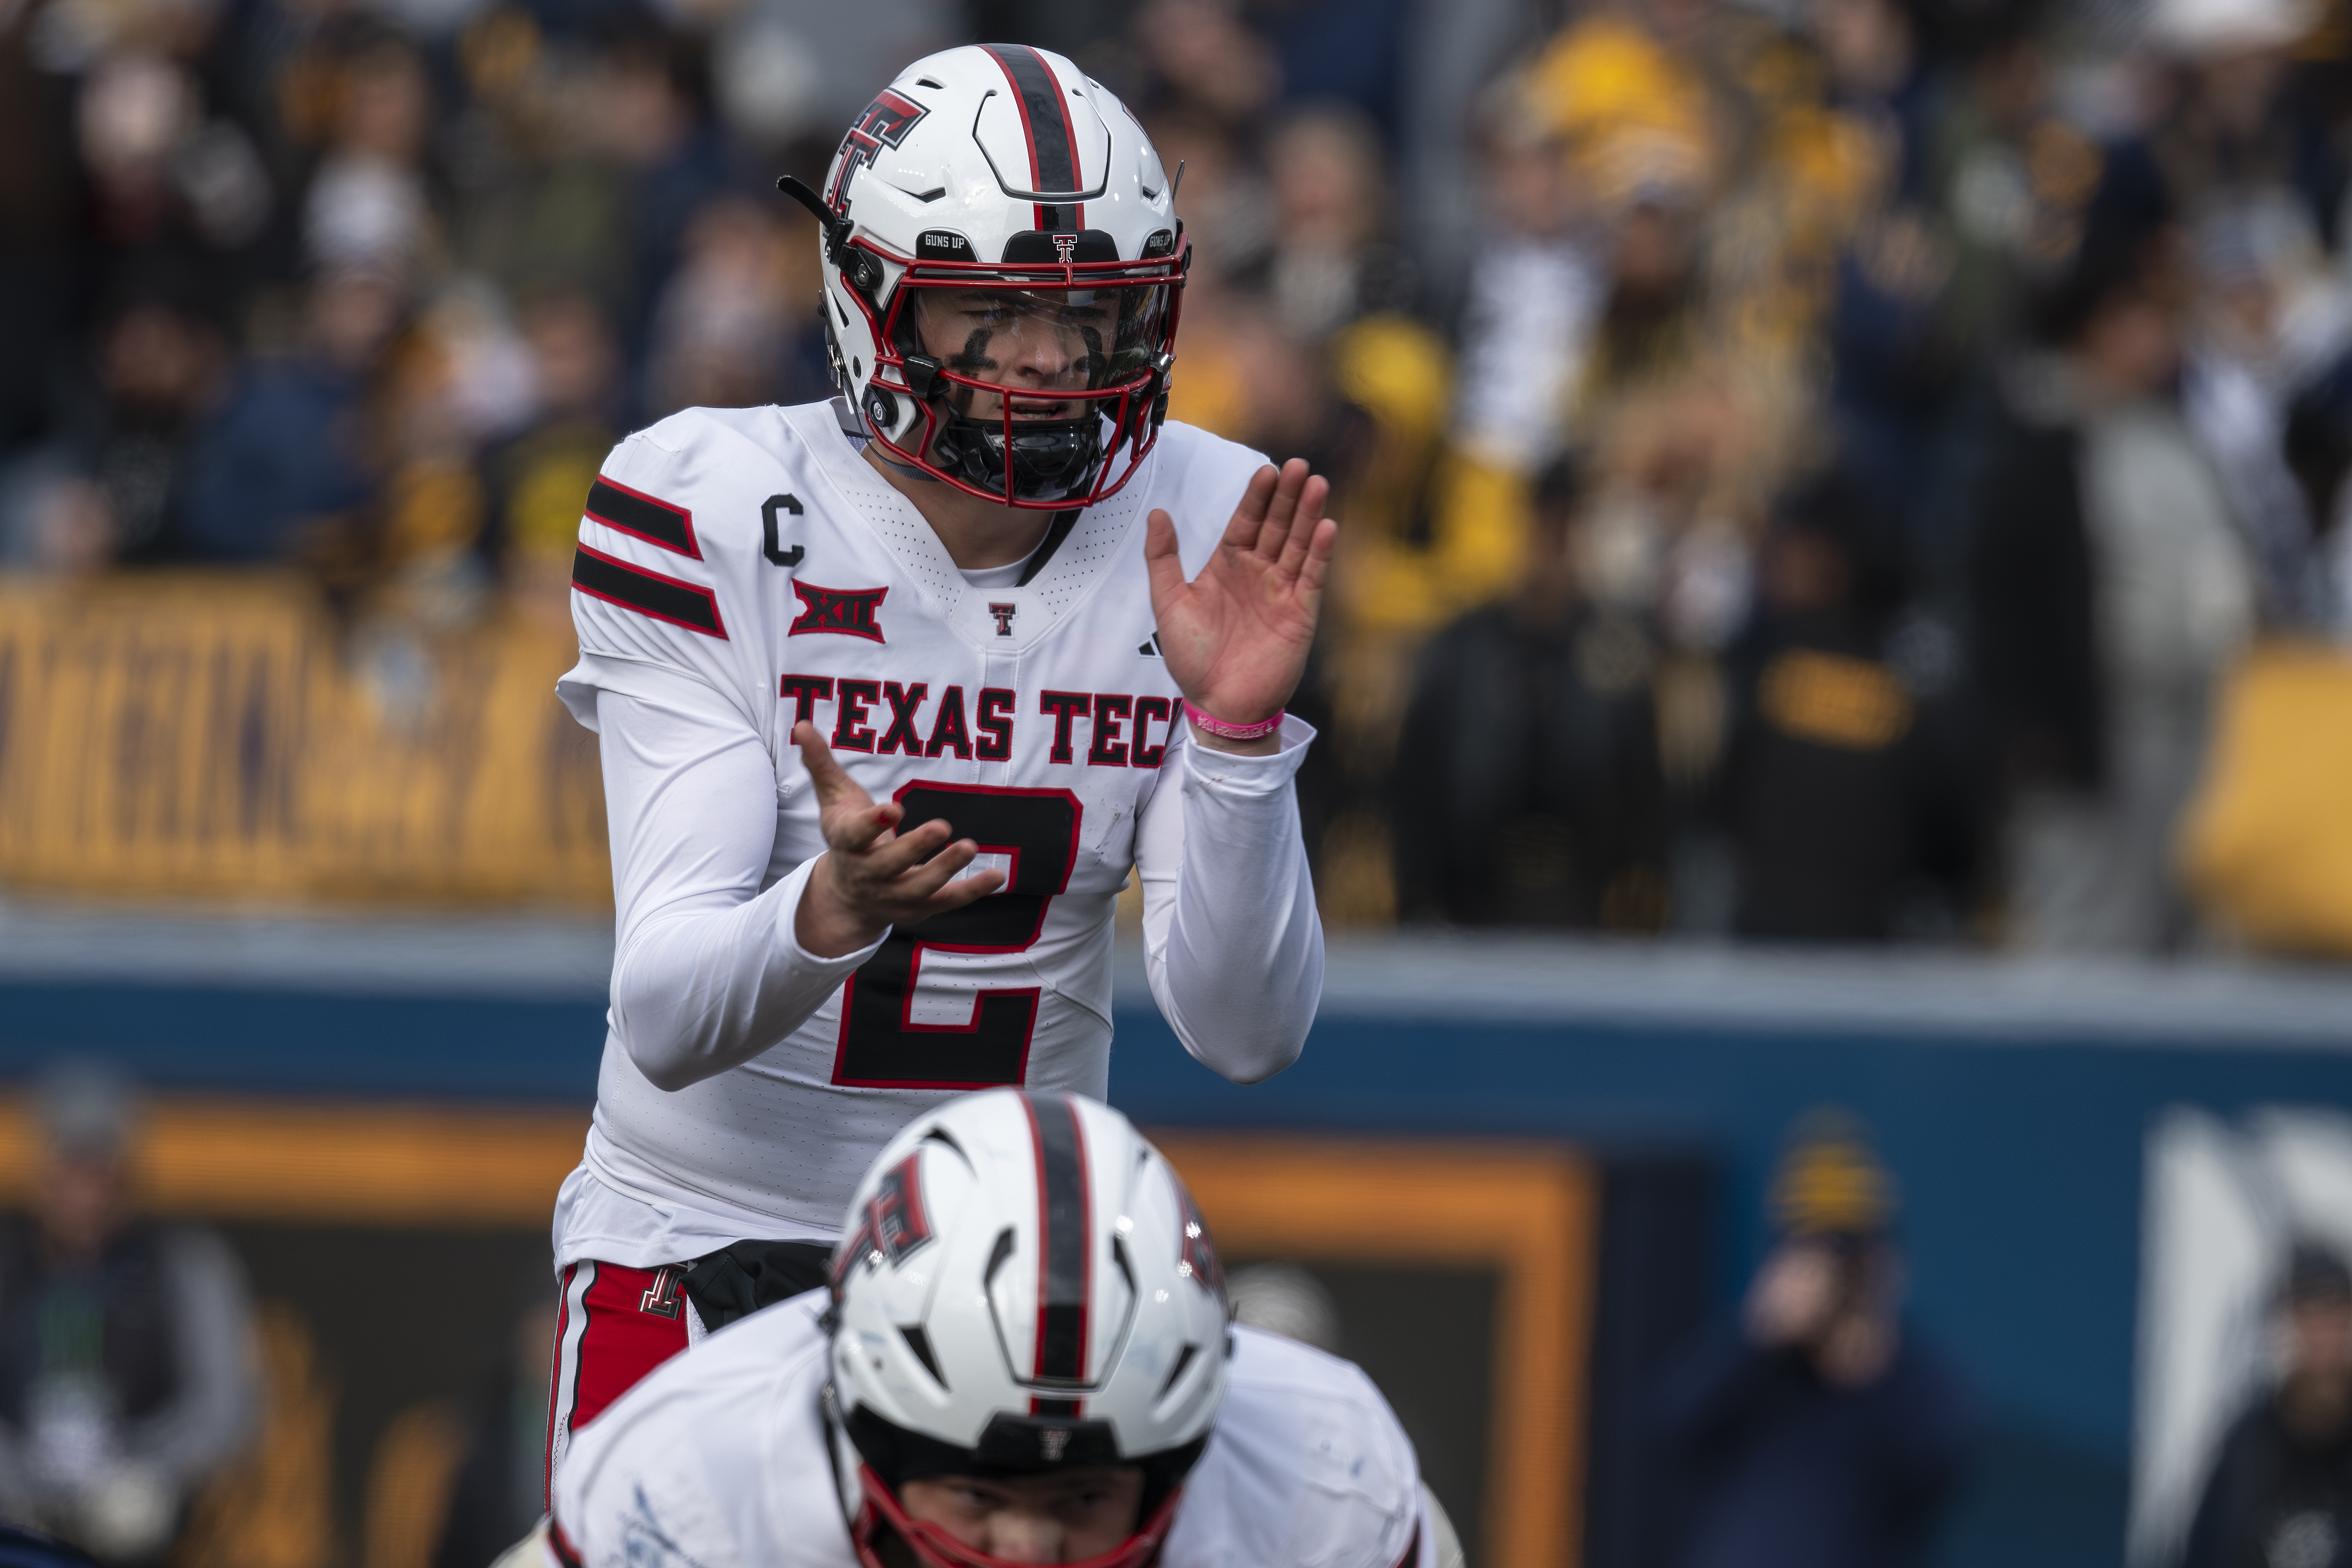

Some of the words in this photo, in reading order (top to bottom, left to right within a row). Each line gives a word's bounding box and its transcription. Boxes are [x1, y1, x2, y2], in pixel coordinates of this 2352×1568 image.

[926, 234, 949, 248] GUNS
[952, 237, 965, 249] UP
[1149, 235, 1164, 248] GUNS
[1164, 234, 1171, 246] UP
[761, 493, 805, 567] C
[780, 674, 1016, 762] TEXAS
[1040, 689, 1184, 769] TEC
[831, 779, 1084, 1090] 2
